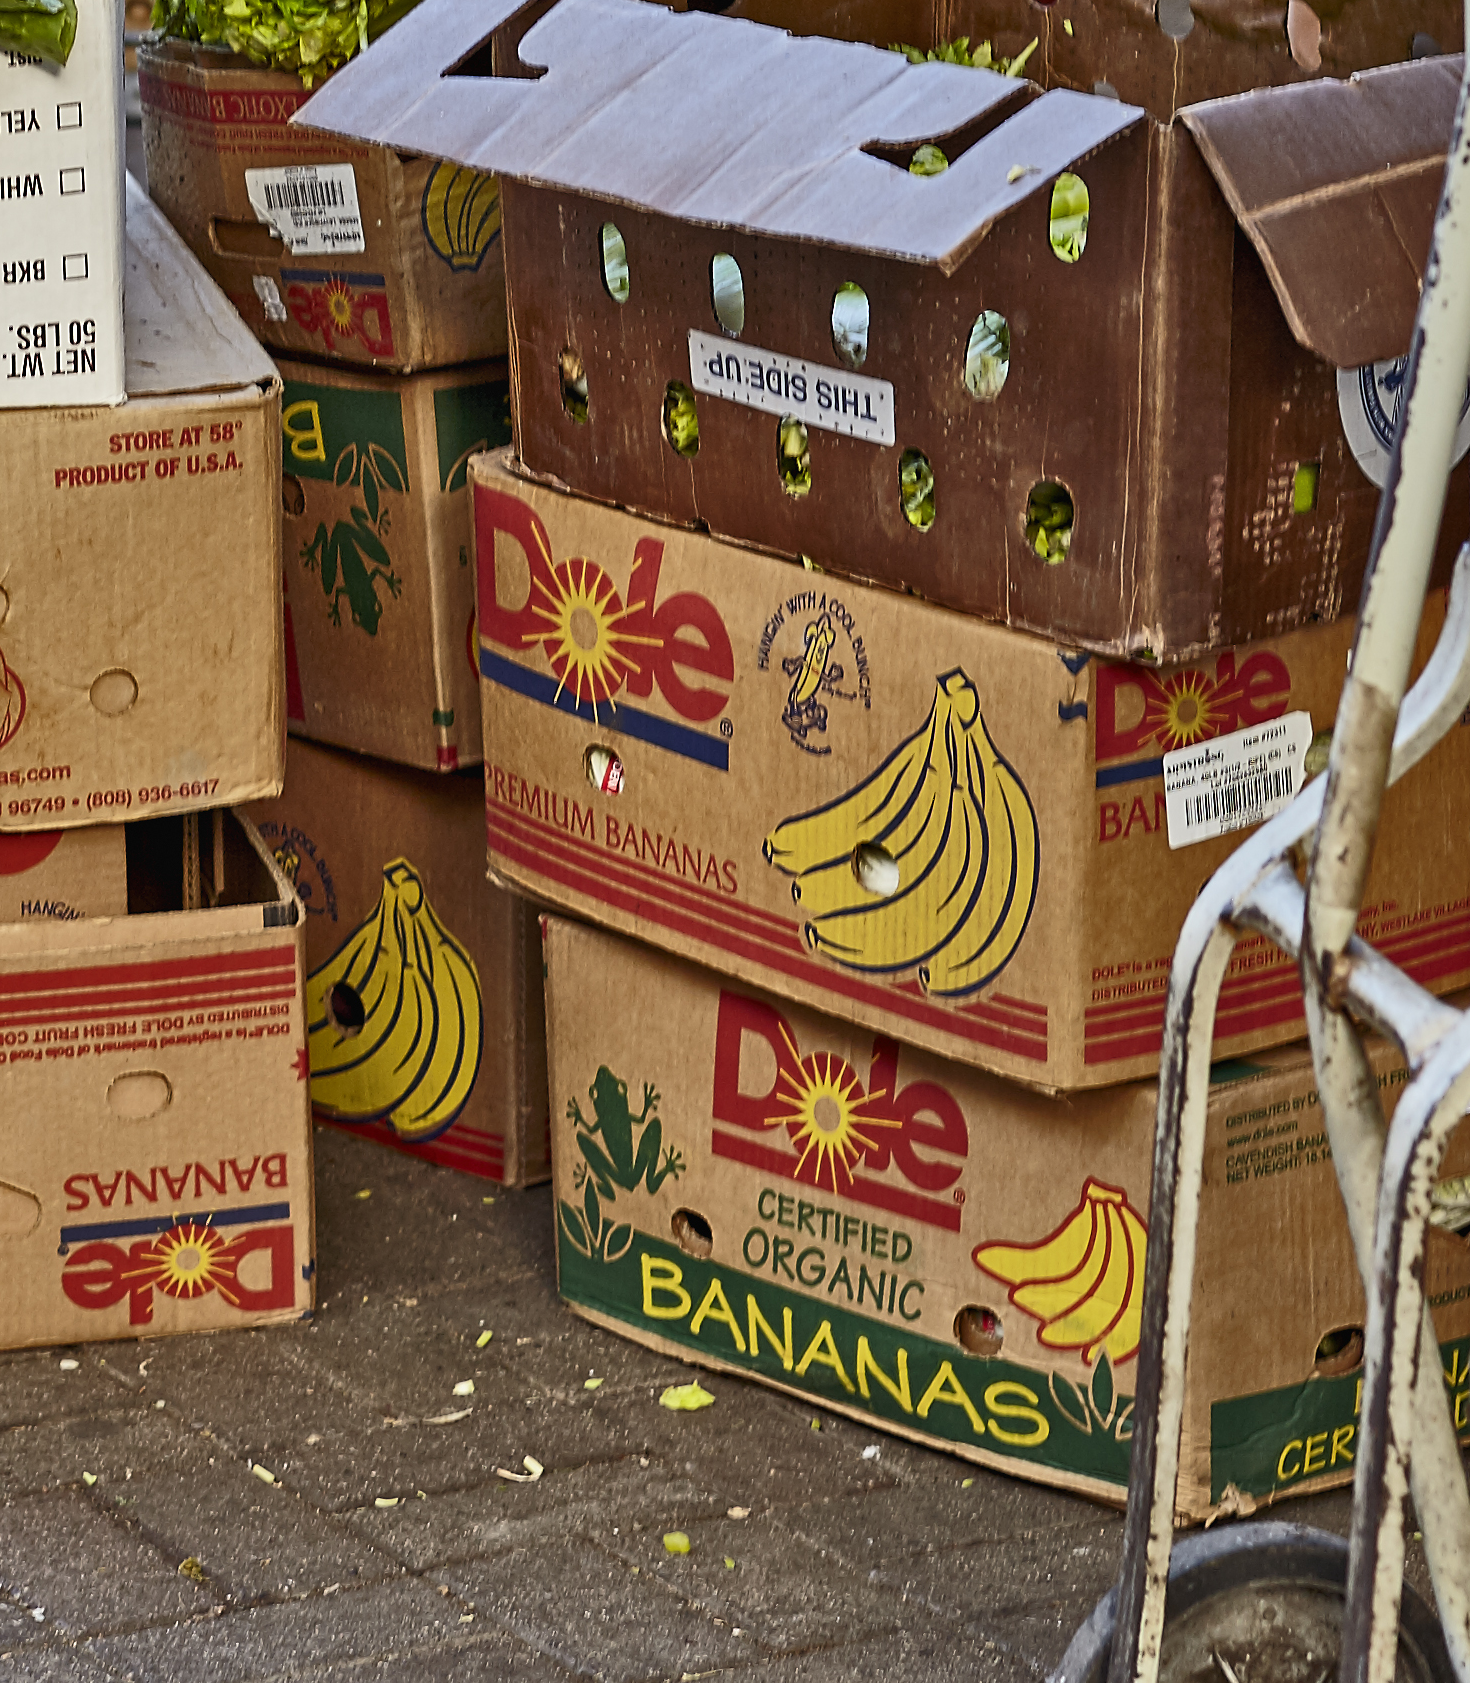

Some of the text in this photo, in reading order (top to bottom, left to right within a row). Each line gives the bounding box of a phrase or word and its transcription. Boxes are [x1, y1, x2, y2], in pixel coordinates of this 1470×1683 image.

[2, 258, 46, 284] BKR
[8, 319, 96, 350] 50 LBS.
[2, 347, 96, 379] NET WT.
[708, 351, 877, 422] THIS SIDE UP
[107, 427, 175, 455] STORE
[180, 425, 204, 451] AT
[54, 451, 244, 489] PRODUCT OF U.S.A.
[474, 482, 735, 724] Dole
[786, 590, 856, 641] WITH A COOL
[1095, 648, 1292, 762] Dole
[8, 795, 66, 817] 96749
[86, 788, 133, 814] (808)
[138, 778, 221, 806] 936-6617
[484, 758, 595, 841] PREMIUM
[605, 814, 738, 893] BANANAS
[33, 1026, 79, 1043] FRUIT
[83, 1021, 136, 1039] FRESH
[141, 1016, 184, 1033] DOLE
[711, 989, 969, 1193] Dole
[1226, 1097, 1305, 1128] DISTRIBUTED BY
[1226, 1142, 1293, 1168] CAVENDISH
[62, 1153, 289, 1212] BANANAS
[756, 1188, 913, 1264] CERTIFIED
[60, 1222, 296, 1327] Dole
[742, 1228, 926, 1323] ORGANIC
[640, 1252, 1050, 1447] BANANAS
